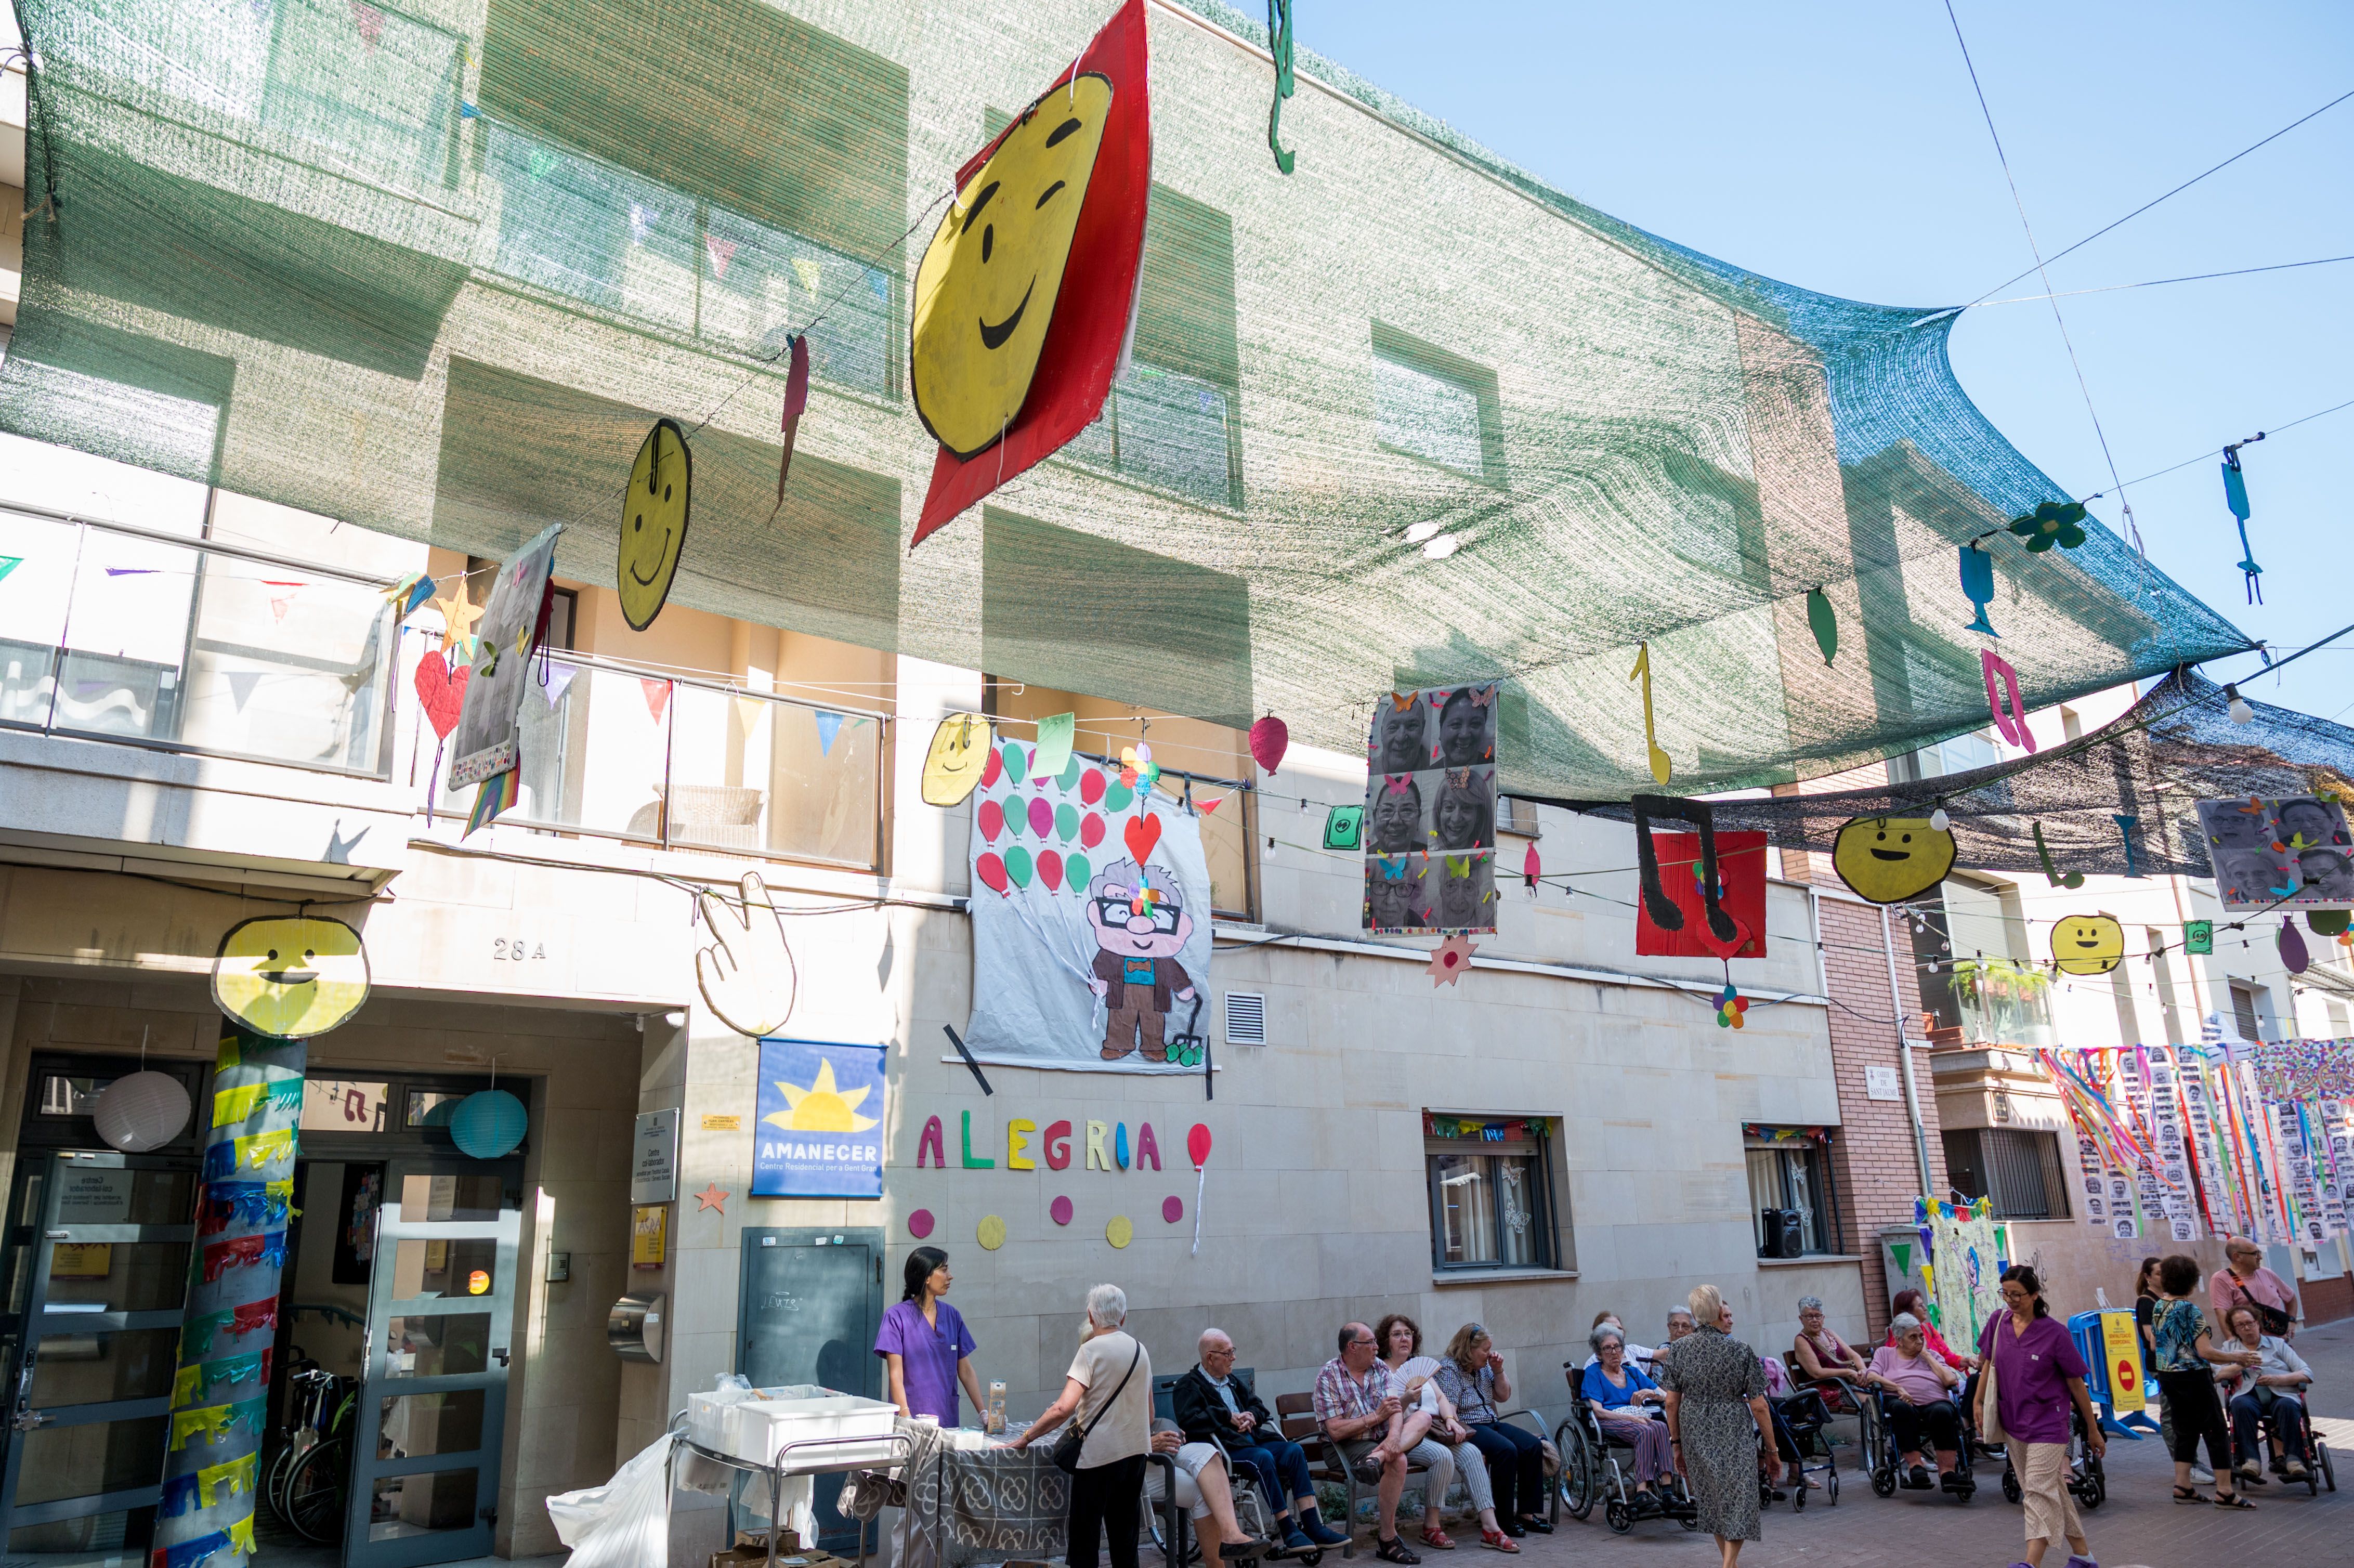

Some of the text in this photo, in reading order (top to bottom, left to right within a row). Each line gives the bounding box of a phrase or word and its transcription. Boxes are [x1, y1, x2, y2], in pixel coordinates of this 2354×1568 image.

[494, 937, 546, 961] 28 A
[917, 1110, 1161, 1171] ALEGRIA
[648, 1148, 660, 1157] Centre
[761, 1142, 877, 1161] AMANECER
[786, 1162, 824, 1171] Residencial
